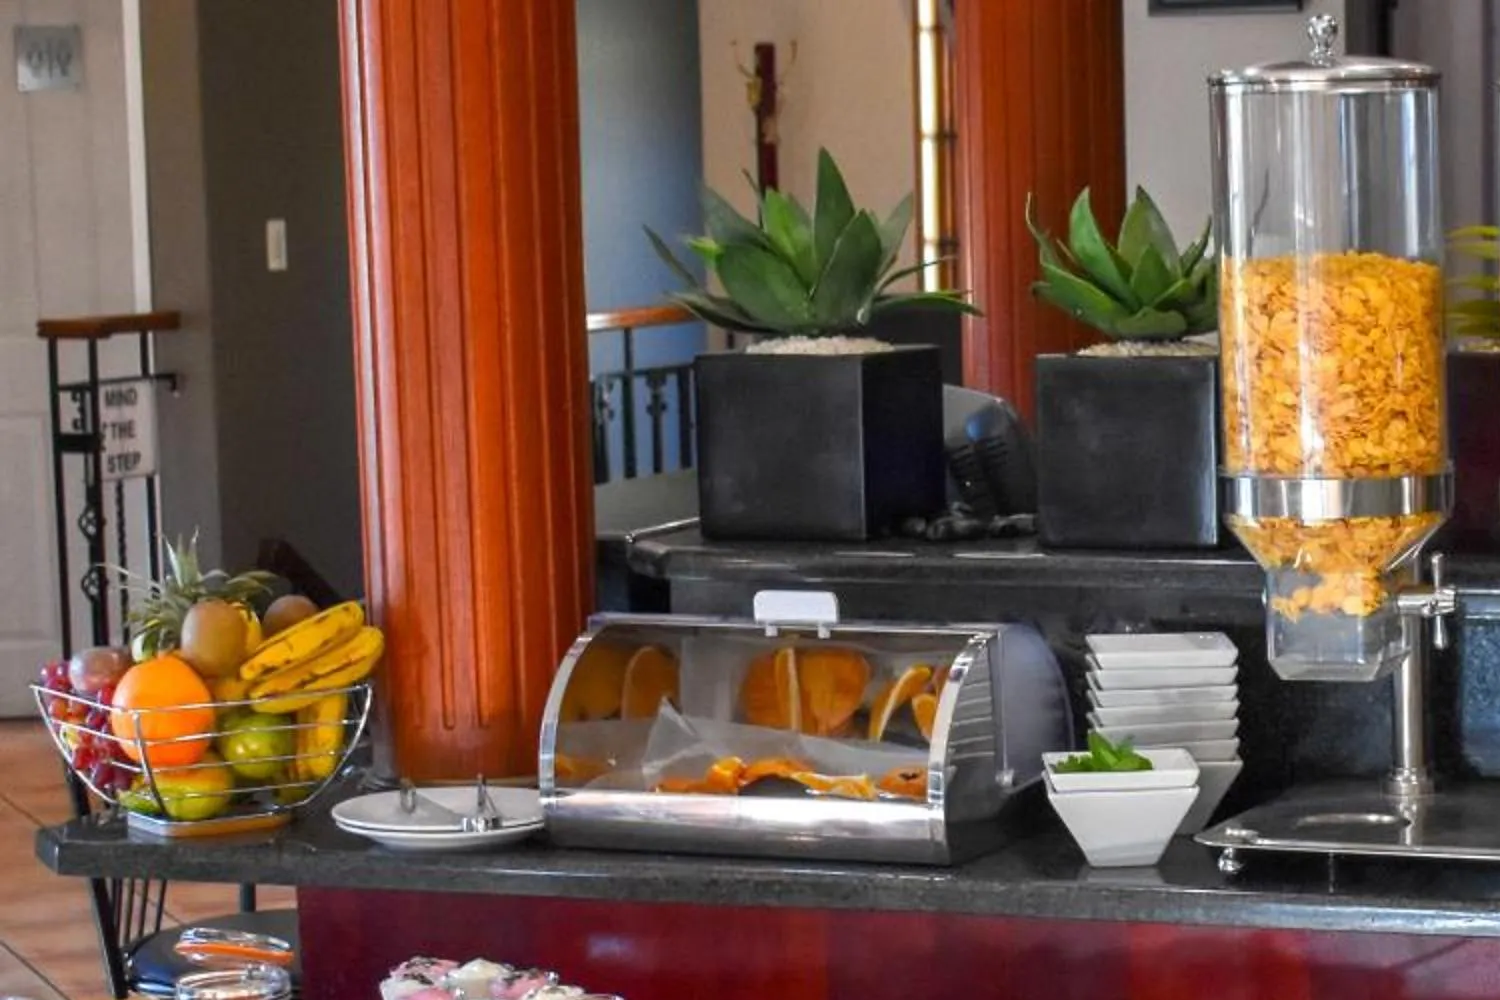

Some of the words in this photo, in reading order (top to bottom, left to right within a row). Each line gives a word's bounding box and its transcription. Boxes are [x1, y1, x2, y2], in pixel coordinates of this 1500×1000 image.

[104, 387, 138, 408] MIND
[110, 421, 137, 440] THE
[107, 452, 141, 474] STEP
